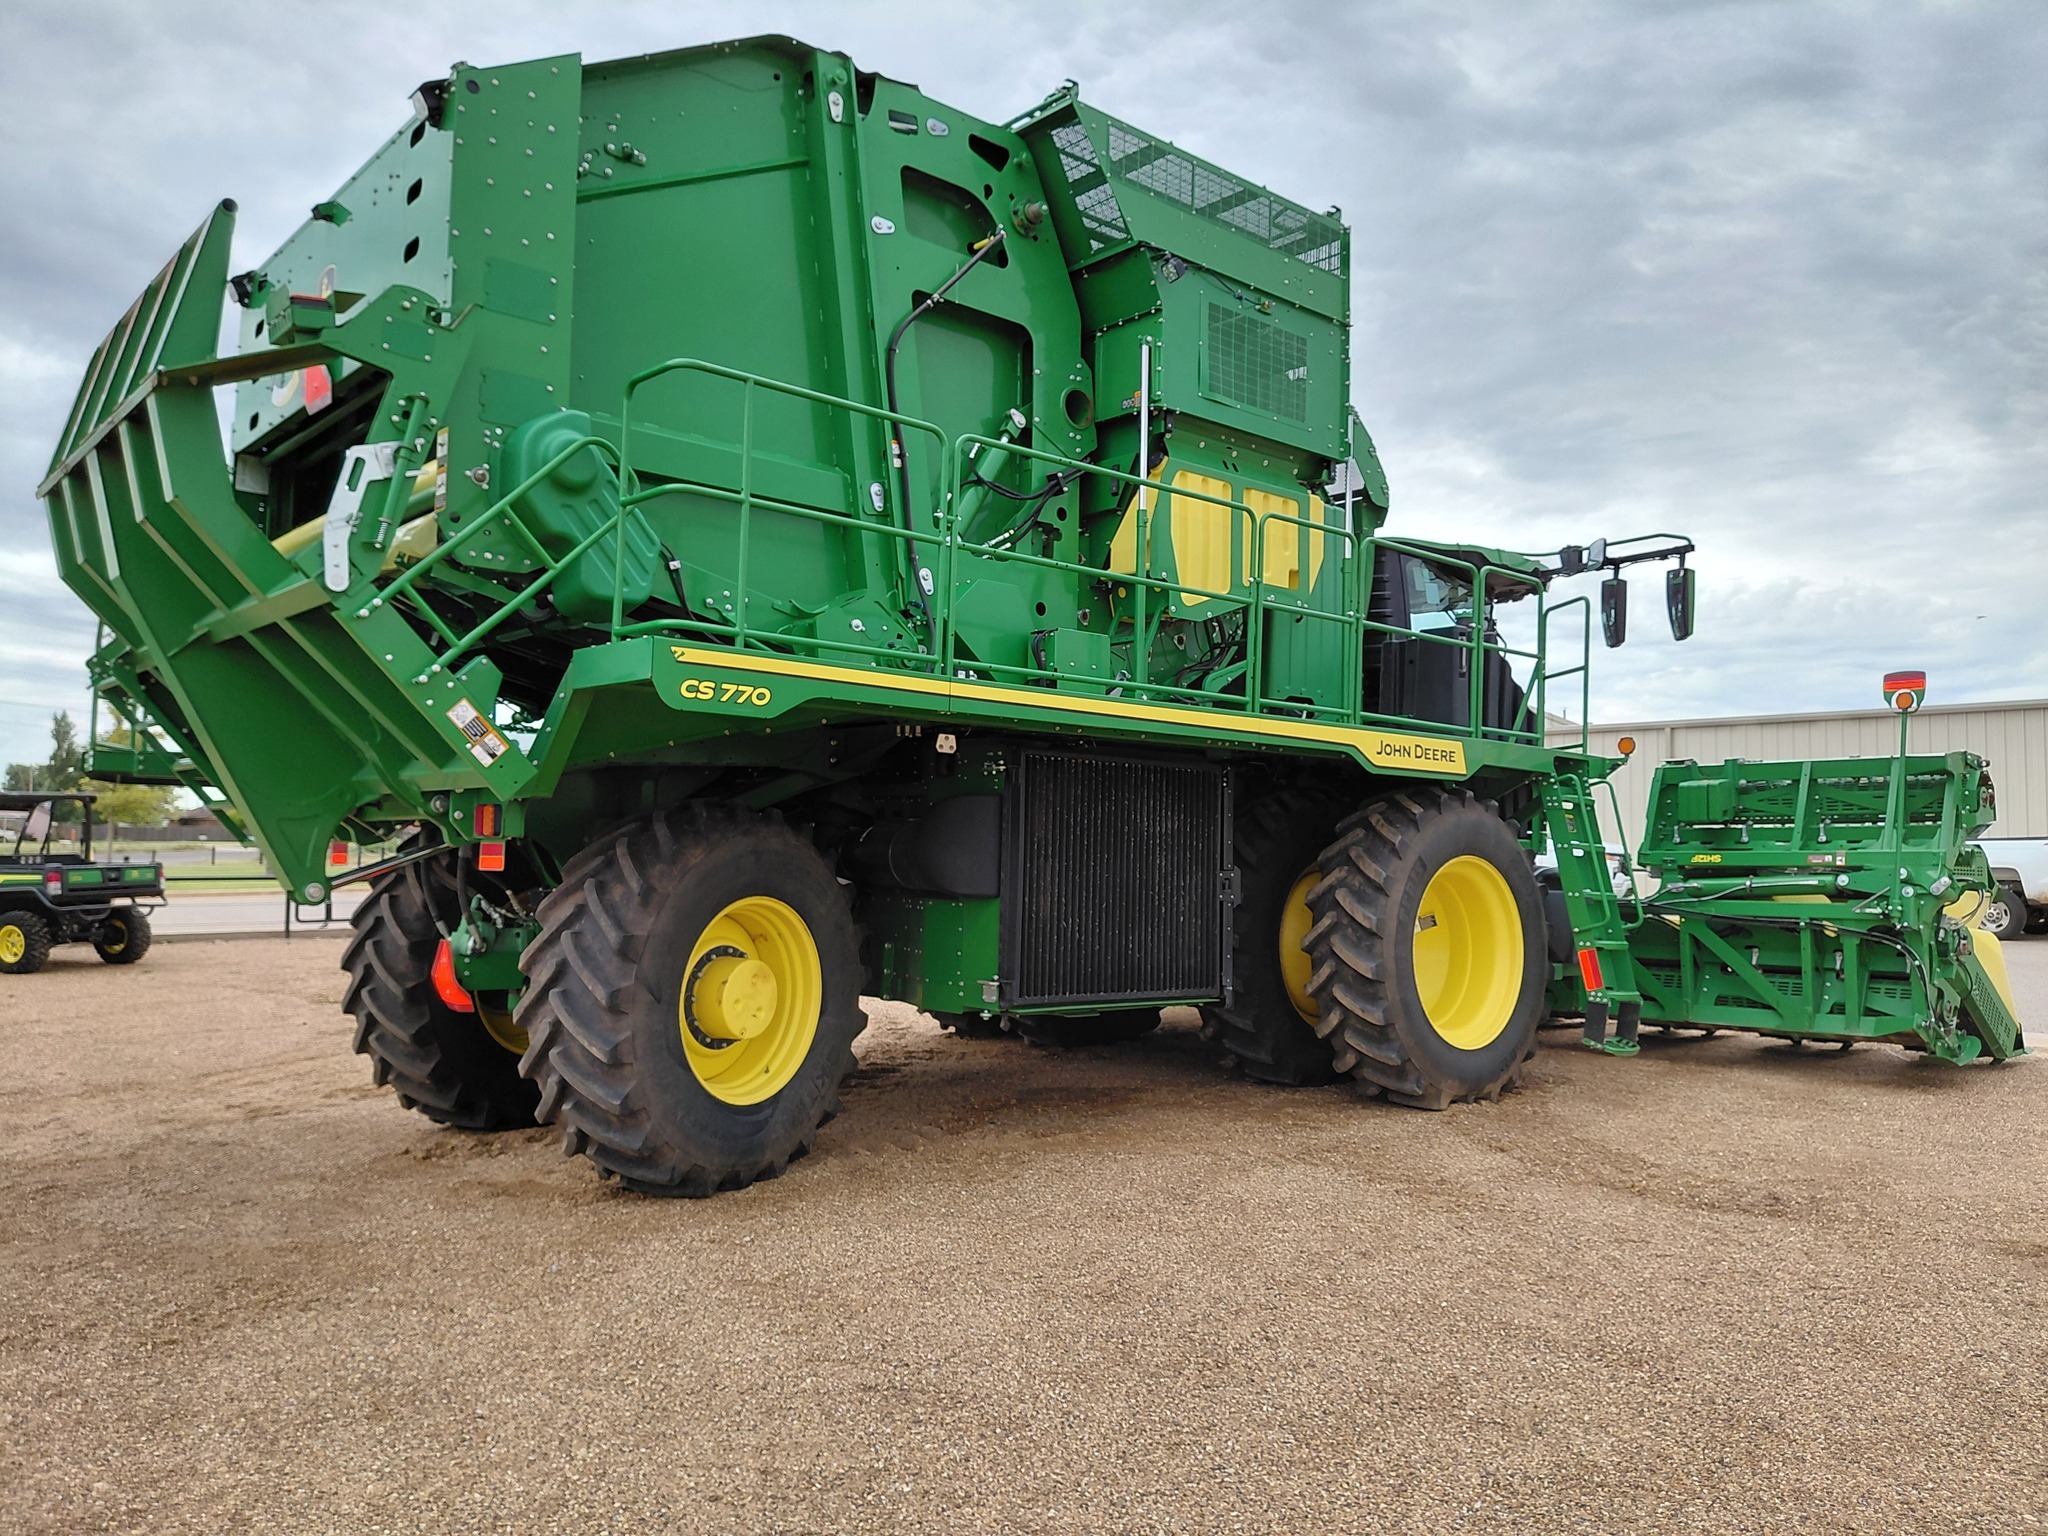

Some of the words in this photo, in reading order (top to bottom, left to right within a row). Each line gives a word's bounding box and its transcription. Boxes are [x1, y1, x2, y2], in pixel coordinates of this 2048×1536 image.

[680, 679, 716, 700] CS
[719, 683, 771, 706] 770
[1376, 740, 1411, 758] JOHN
[1414, 744, 1456, 763] DEERE
